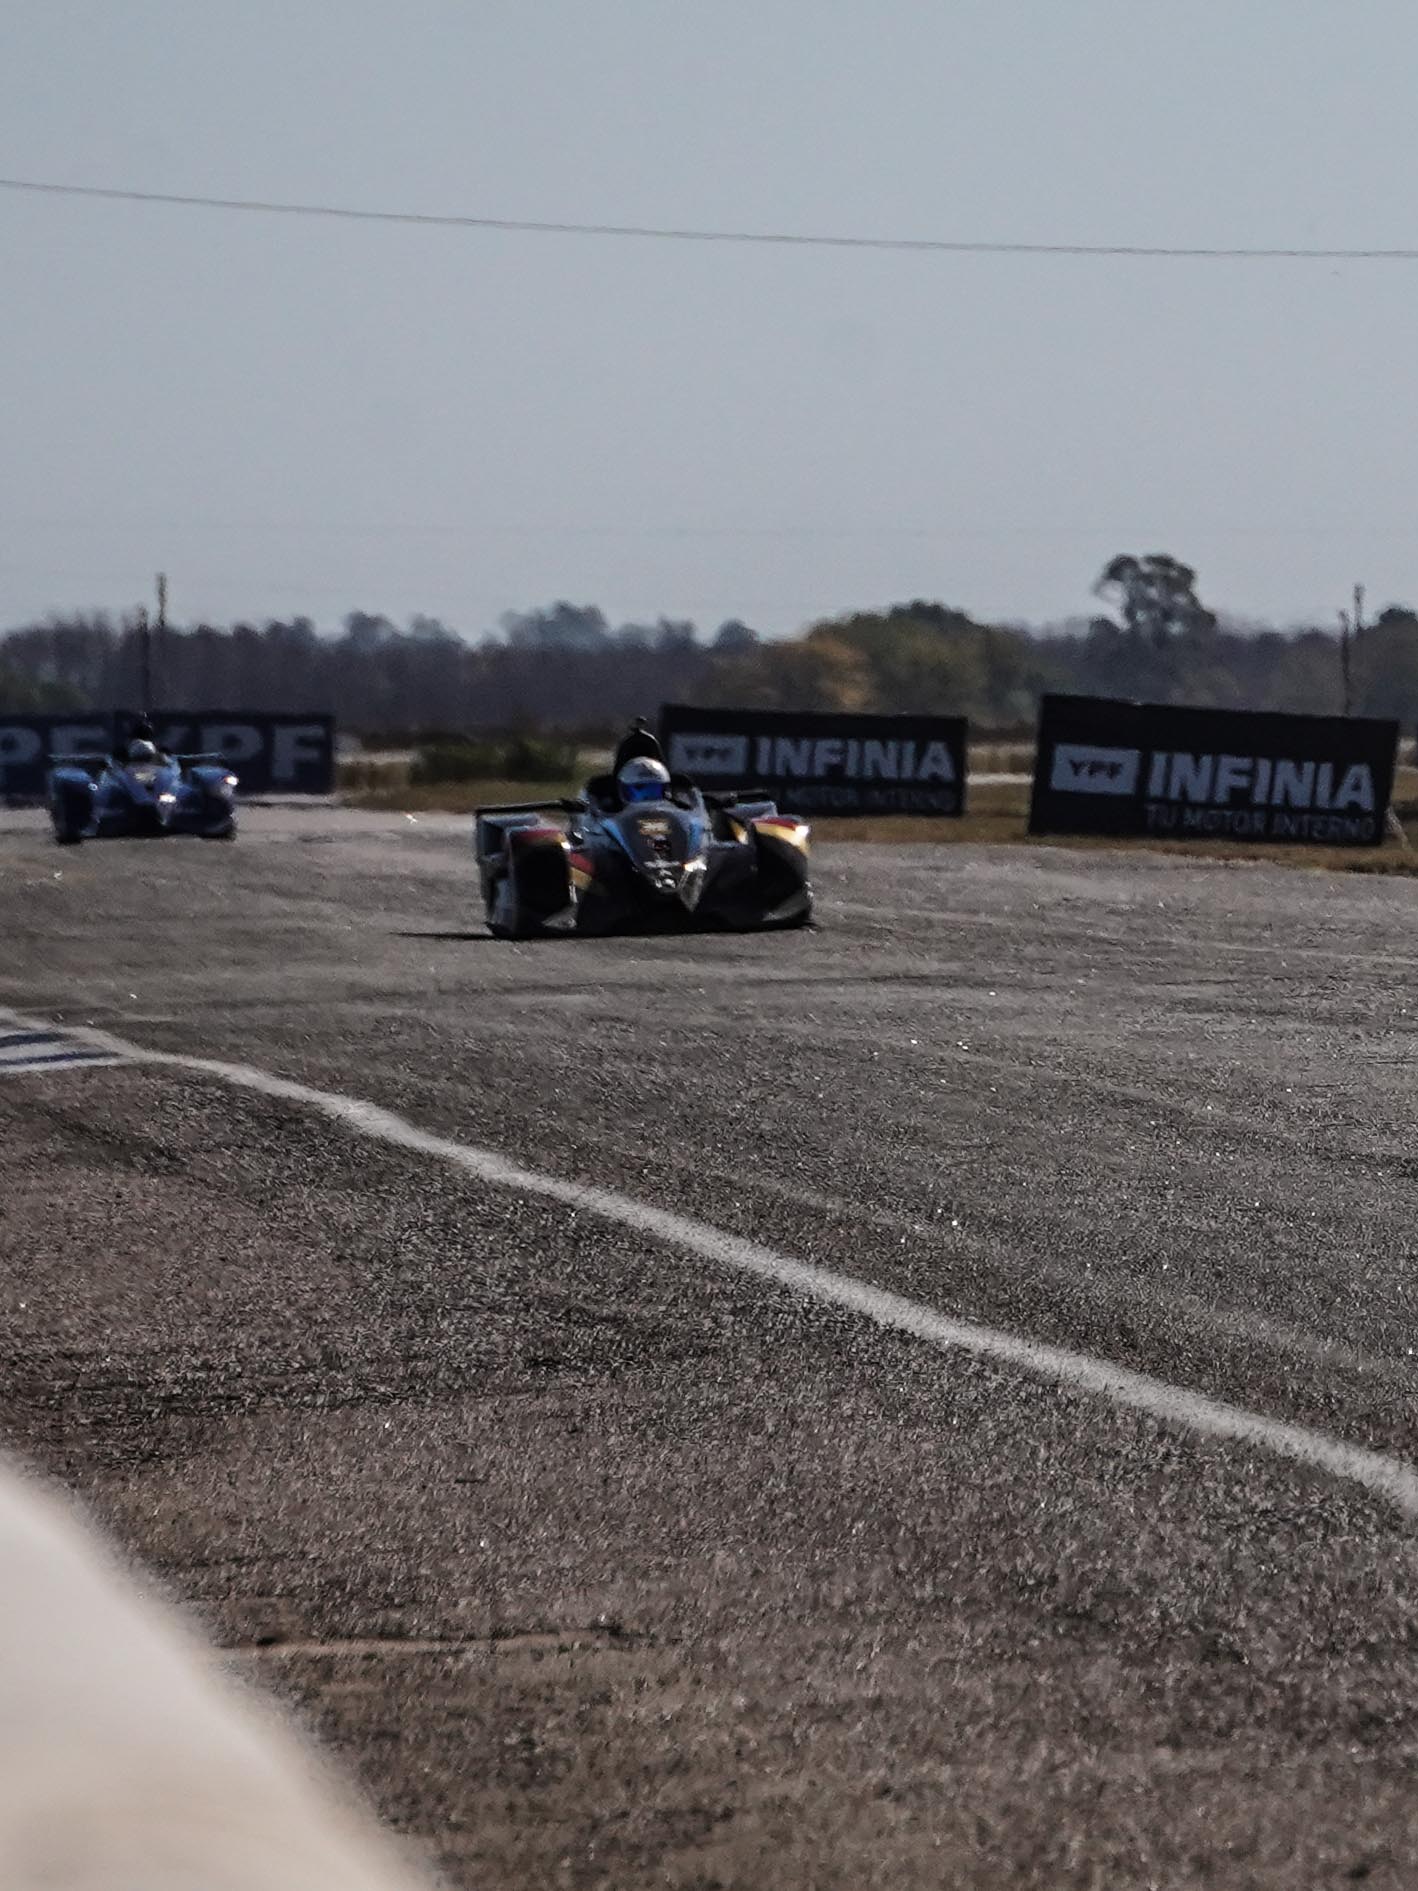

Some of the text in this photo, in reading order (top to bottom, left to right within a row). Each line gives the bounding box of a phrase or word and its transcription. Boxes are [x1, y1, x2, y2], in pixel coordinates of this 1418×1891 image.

[755, 735, 956, 780] INFINIA
[1068, 758, 1123, 779] YPF
[1146, 750, 1376, 812] INFINIA
[1143, 803, 1377, 841] TU MOTOR INTERNO
